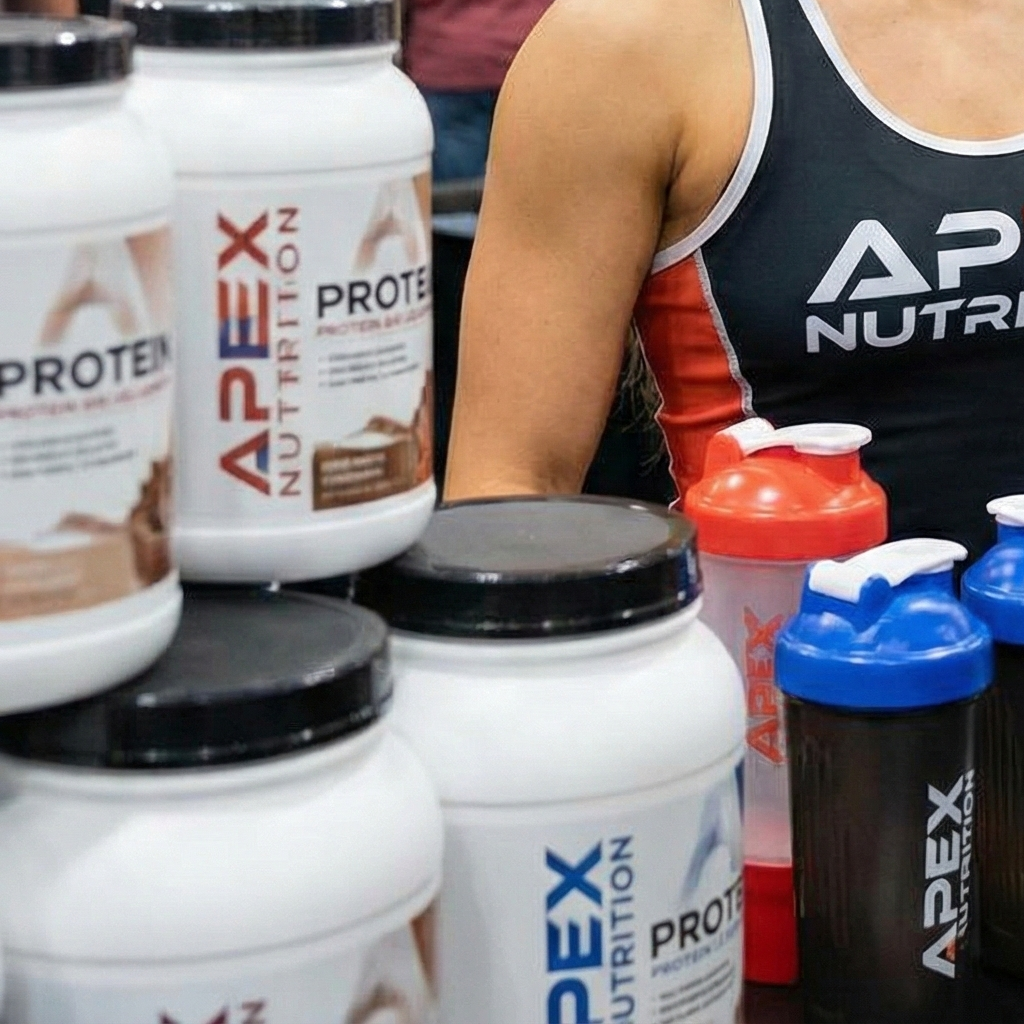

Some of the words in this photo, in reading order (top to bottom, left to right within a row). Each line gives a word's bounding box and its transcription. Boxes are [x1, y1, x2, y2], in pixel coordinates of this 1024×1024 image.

[217, 209, 269, 496] APEX
[609, 834, 635, 1024] UTRITION
[922, 774, 965, 979] APEX
